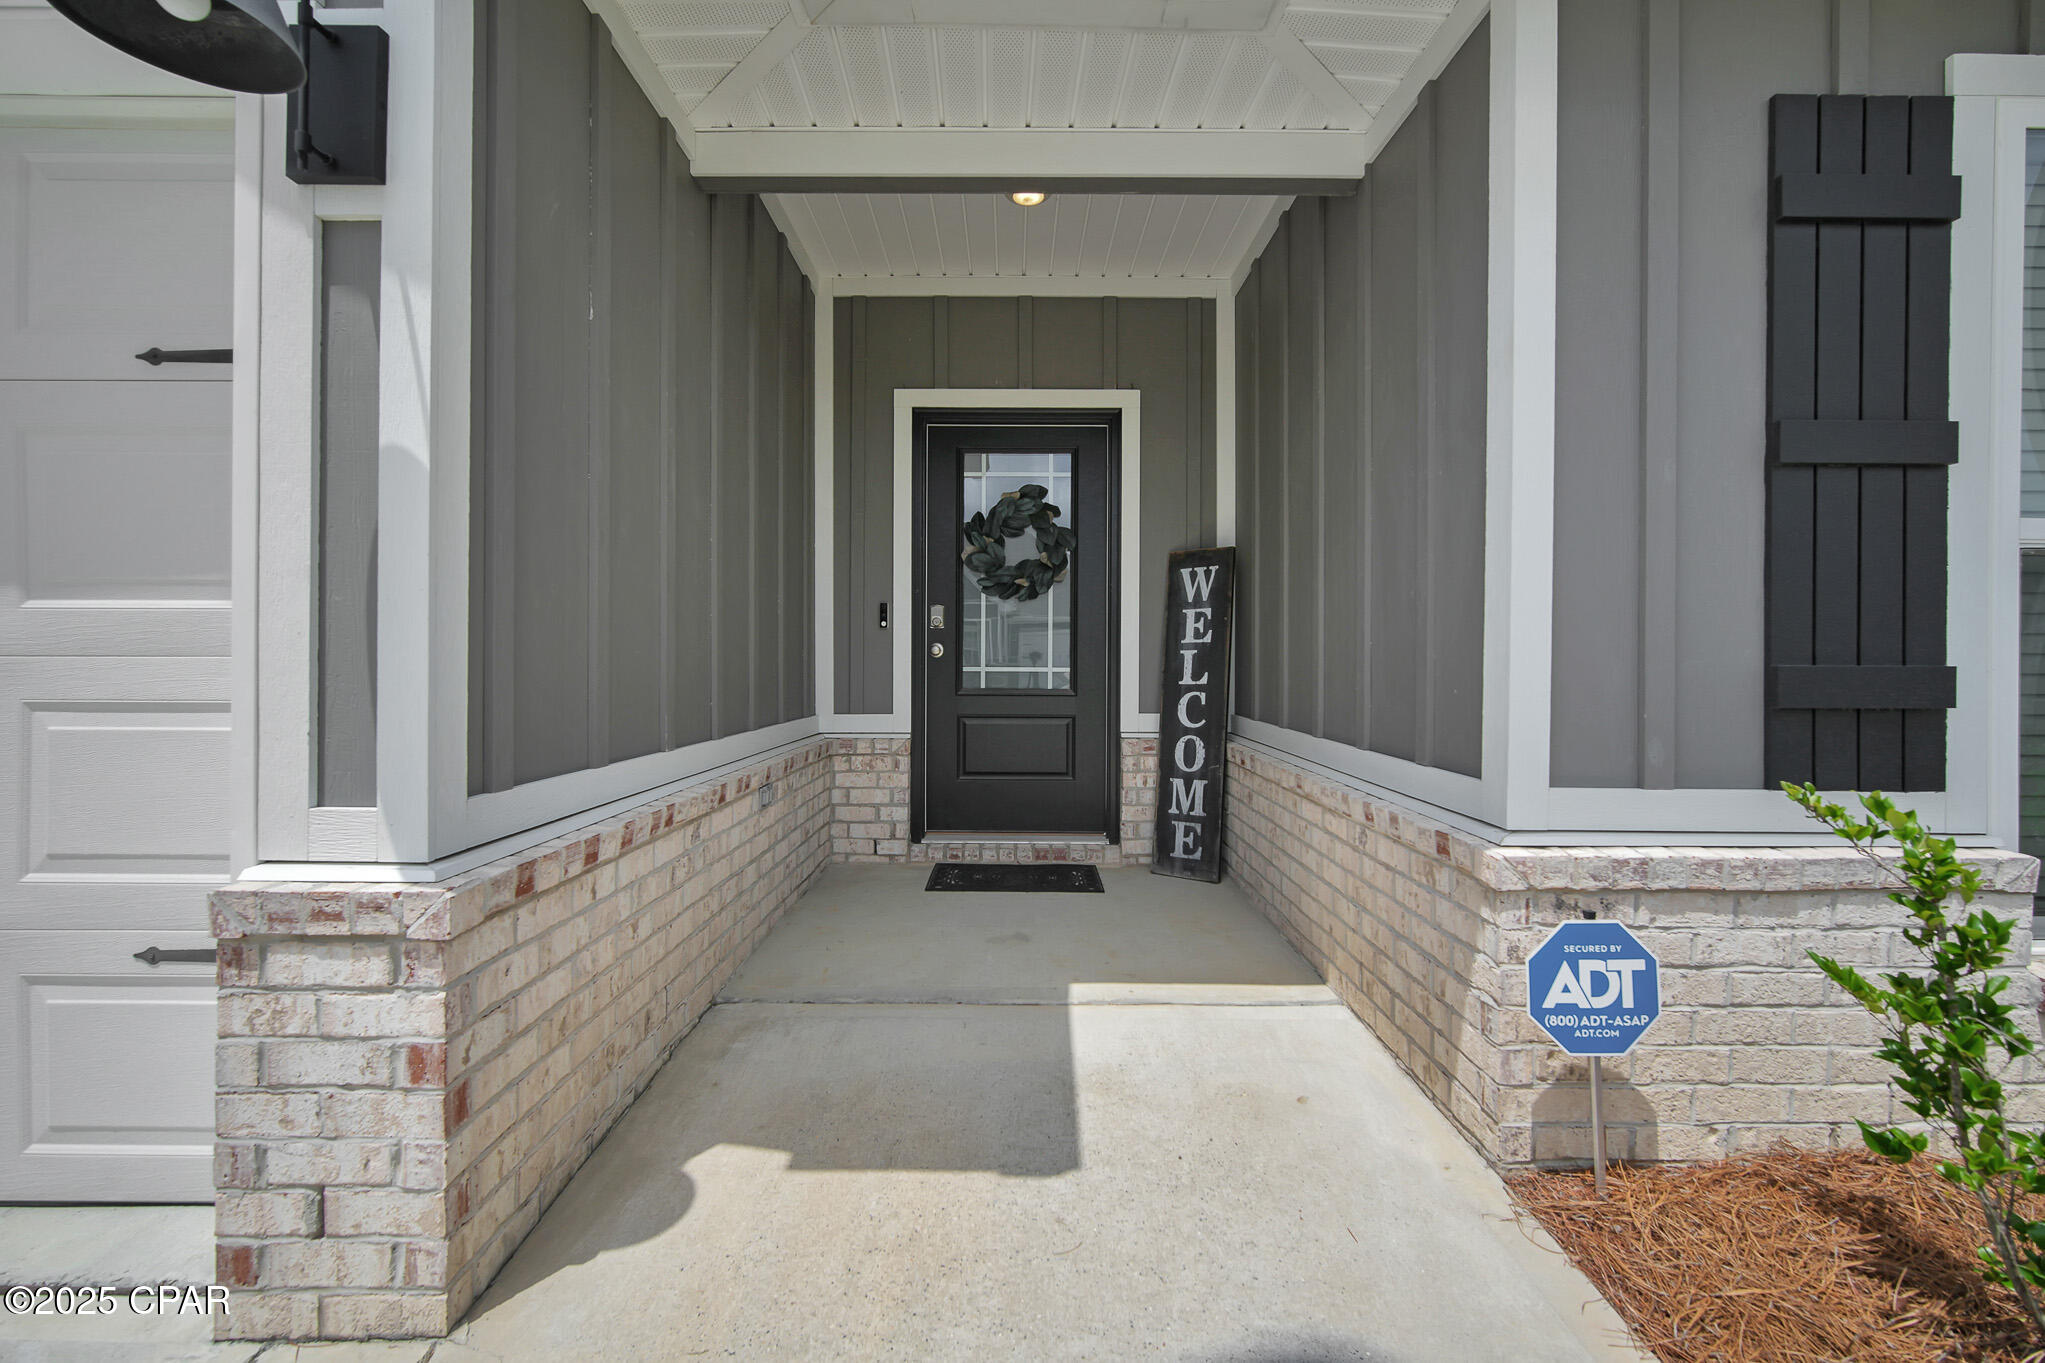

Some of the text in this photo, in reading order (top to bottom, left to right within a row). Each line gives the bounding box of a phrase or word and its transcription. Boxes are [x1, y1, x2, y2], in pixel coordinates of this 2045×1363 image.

[1168, 565, 1219, 861] WELCOME
[1563, 945, 1622, 953] SECURED BY
[1542, 959, 1646, 1009] ADT
[1544, 1014, 1650, 1028] (800) ADT-ASAP
[1574, 1029, 1620, 1038] ADT.COM
